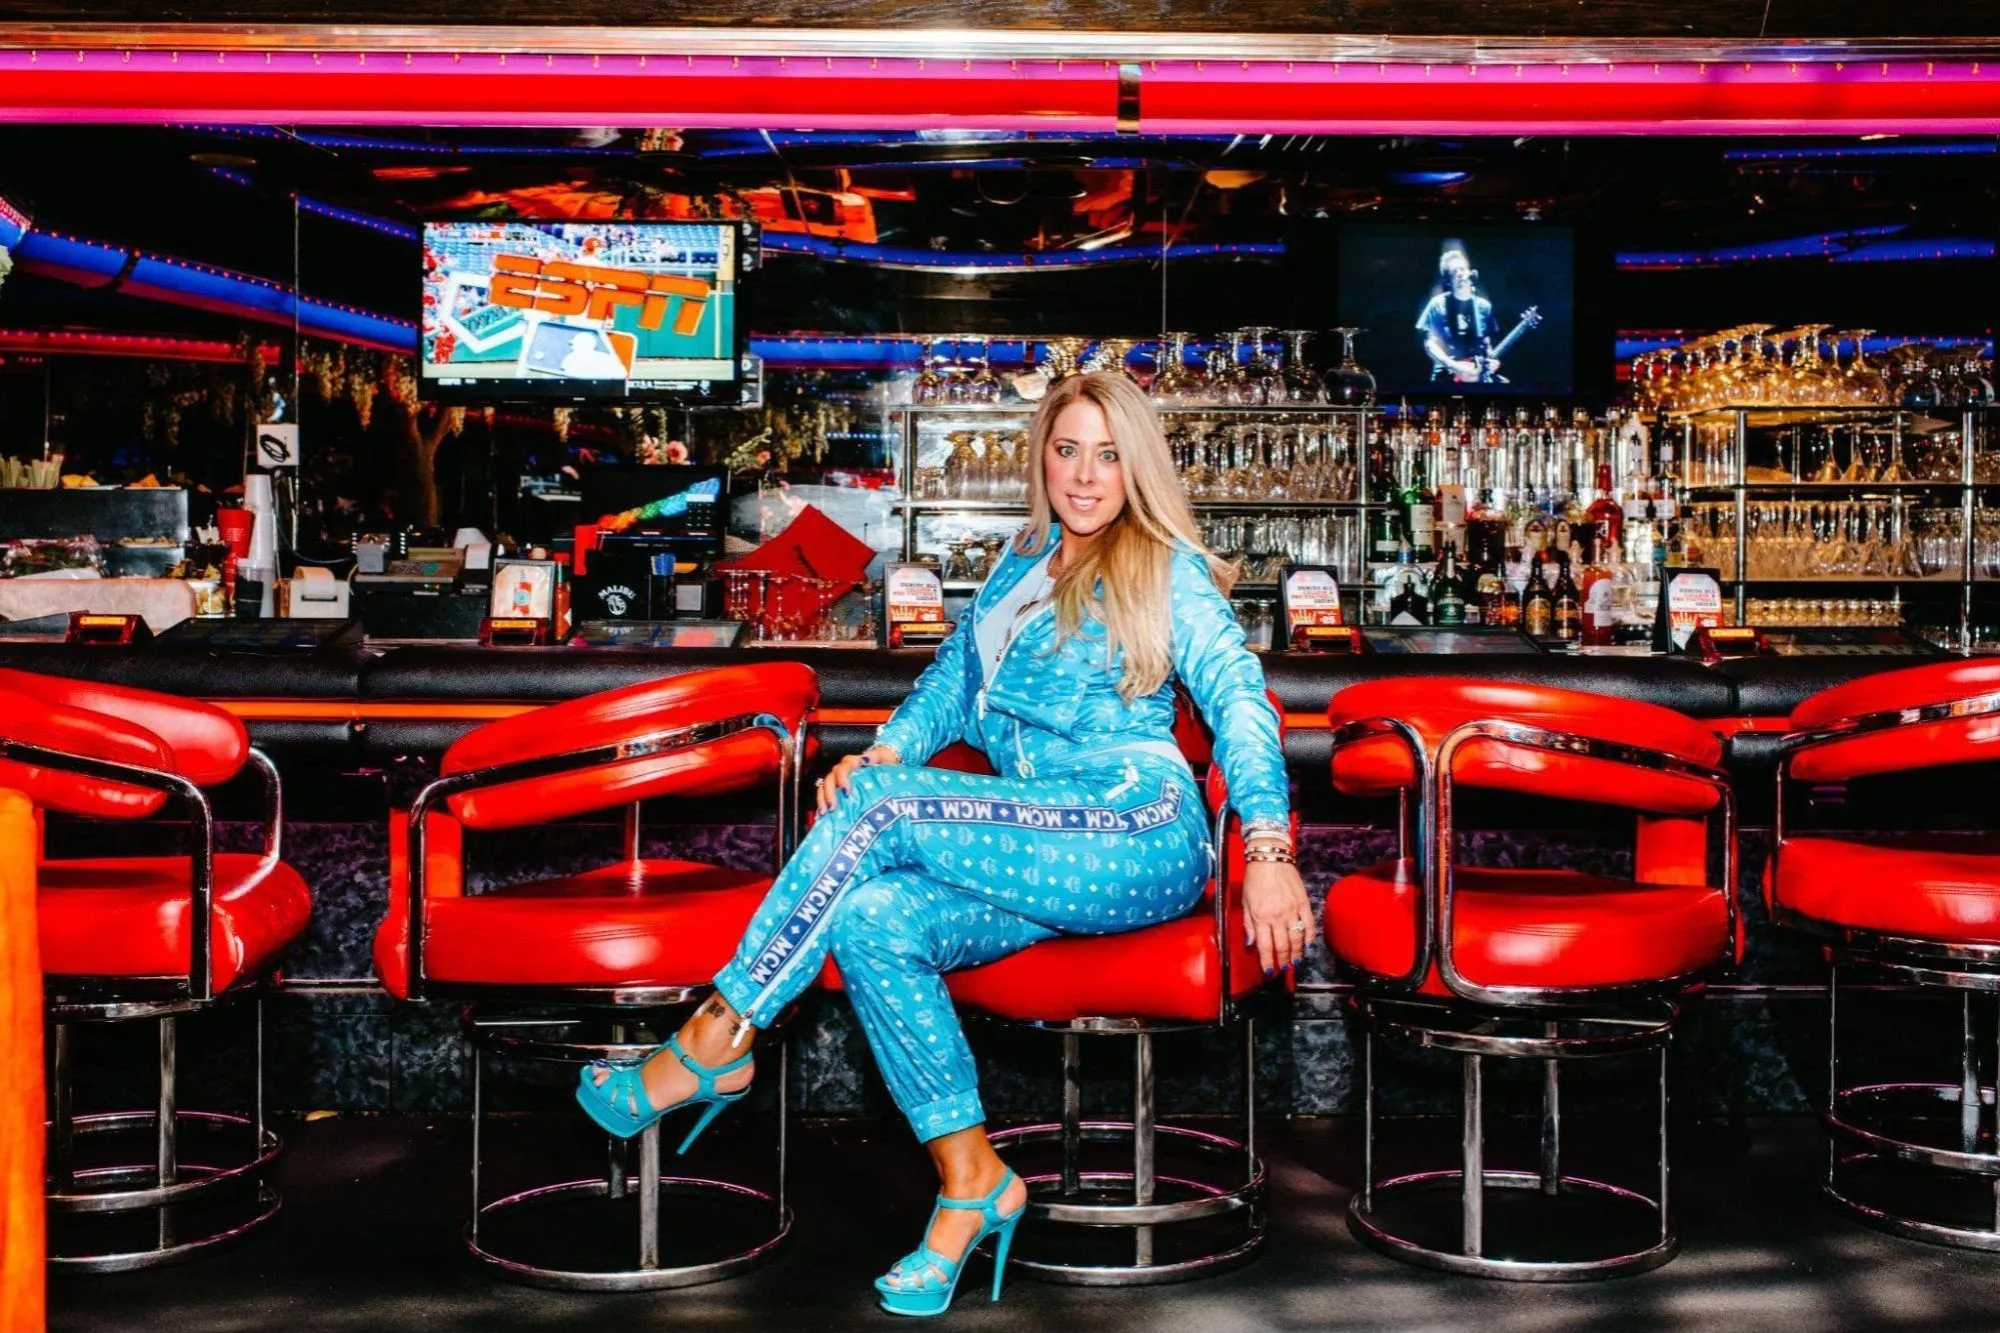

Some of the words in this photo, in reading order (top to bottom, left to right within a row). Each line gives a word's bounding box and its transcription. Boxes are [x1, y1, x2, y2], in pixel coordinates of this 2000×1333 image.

[489, 253, 711, 336] ESPN
[598, 584, 637, 600] MALIBU
[941, 800, 993, 820] MCM
[1015, 805, 1063, 828] MCM
[1131, 802, 1176, 829] MCM
[841, 818, 877, 861] MCM
[797, 872, 839, 924] MCM
[751, 934, 793, 984] MCM
